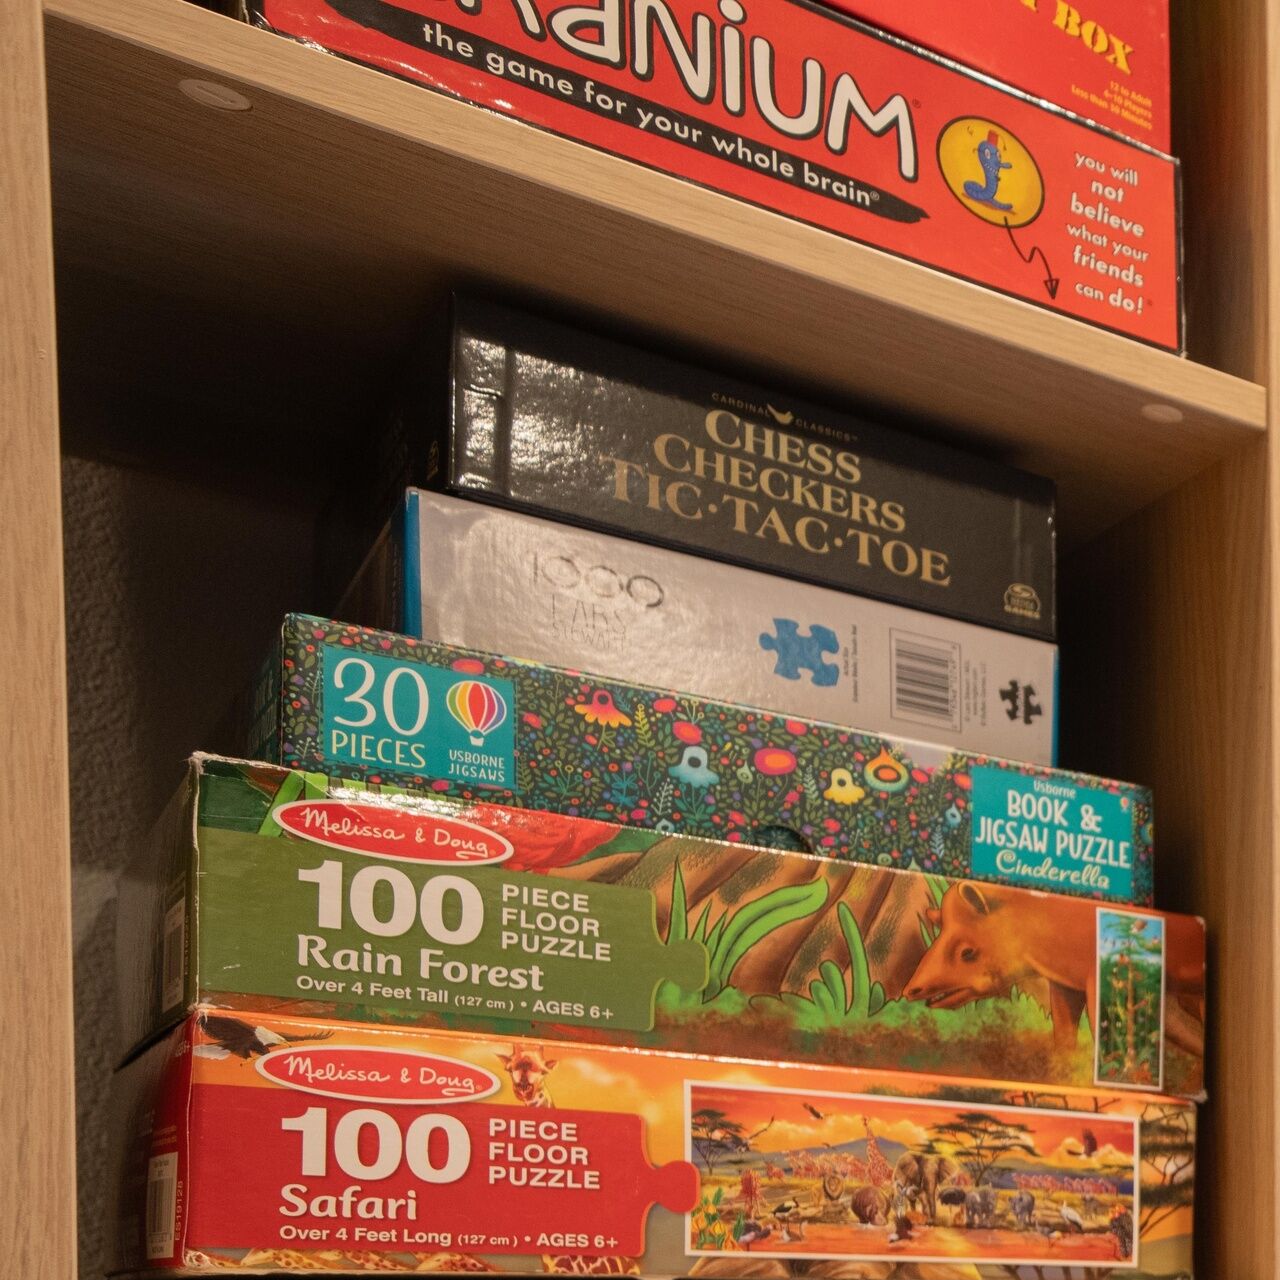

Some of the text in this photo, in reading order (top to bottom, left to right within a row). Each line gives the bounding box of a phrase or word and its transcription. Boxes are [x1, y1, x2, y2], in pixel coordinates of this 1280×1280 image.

[1052, 0, 1135, 76] BOX
[422, 22, 474, 58] the
[485, 50, 575, 97] game
[583, 80, 627, 115] for
[637, 106, 703, 144] your
[709, 135, 795, 179] whole
[1074, 152, 1138, 187] you will
[1091, 178, 1126, 204] not
[1071, 192, 1145, 238] believe
[1066, 222, 1149, 263] what your
[1073, 245, 1144, 288] friends
[1075, 281, 1144, 315] can do!
[711, 392, 771, 418] CARDINAL
[704, 408, 863, 484] CHESS
[653, 432, 908, 535] CHECKERS
[332, 657, 430, 737] 30
[331, 729, 427, 770] PIECES
[448, 748, 506, 770] USBORNE
[448, 762, 506, 783] JIGSAWS
[1034, 779, 1077, 799] Usborne
[1007, 789, 1103, 833] BOOK &
[299, 806, 490, 859] Melissa Doug
[975, 815, 1132, 869] JIGSAW PUZZLE
[996, 849, 1111, 890] Cinderella
[298, 859, 485, 946] 100
[502, 883, 590, 913] PIECE
[502, 908, 601, 938] FLOOR
[297, 933, 546, 992] Rain Forest
[502, 933, 612, 963] PUZZLE
[296, 974, 615, 1021] Over Feet Tall AGES 6+
[284, 1053, 391, 1084] Melissa
[281, 1106, 472, 1184] 100
[488, 1118, 579, 1142] PIECE
[488, 1142, 590, 1166] FLOOR
[488, 1166, 601, 1190] PUZZLE
[279, 1183, 418, 1221] Safari
[279, 1225, 619, 1250] Over Feet Long AGES 6+
